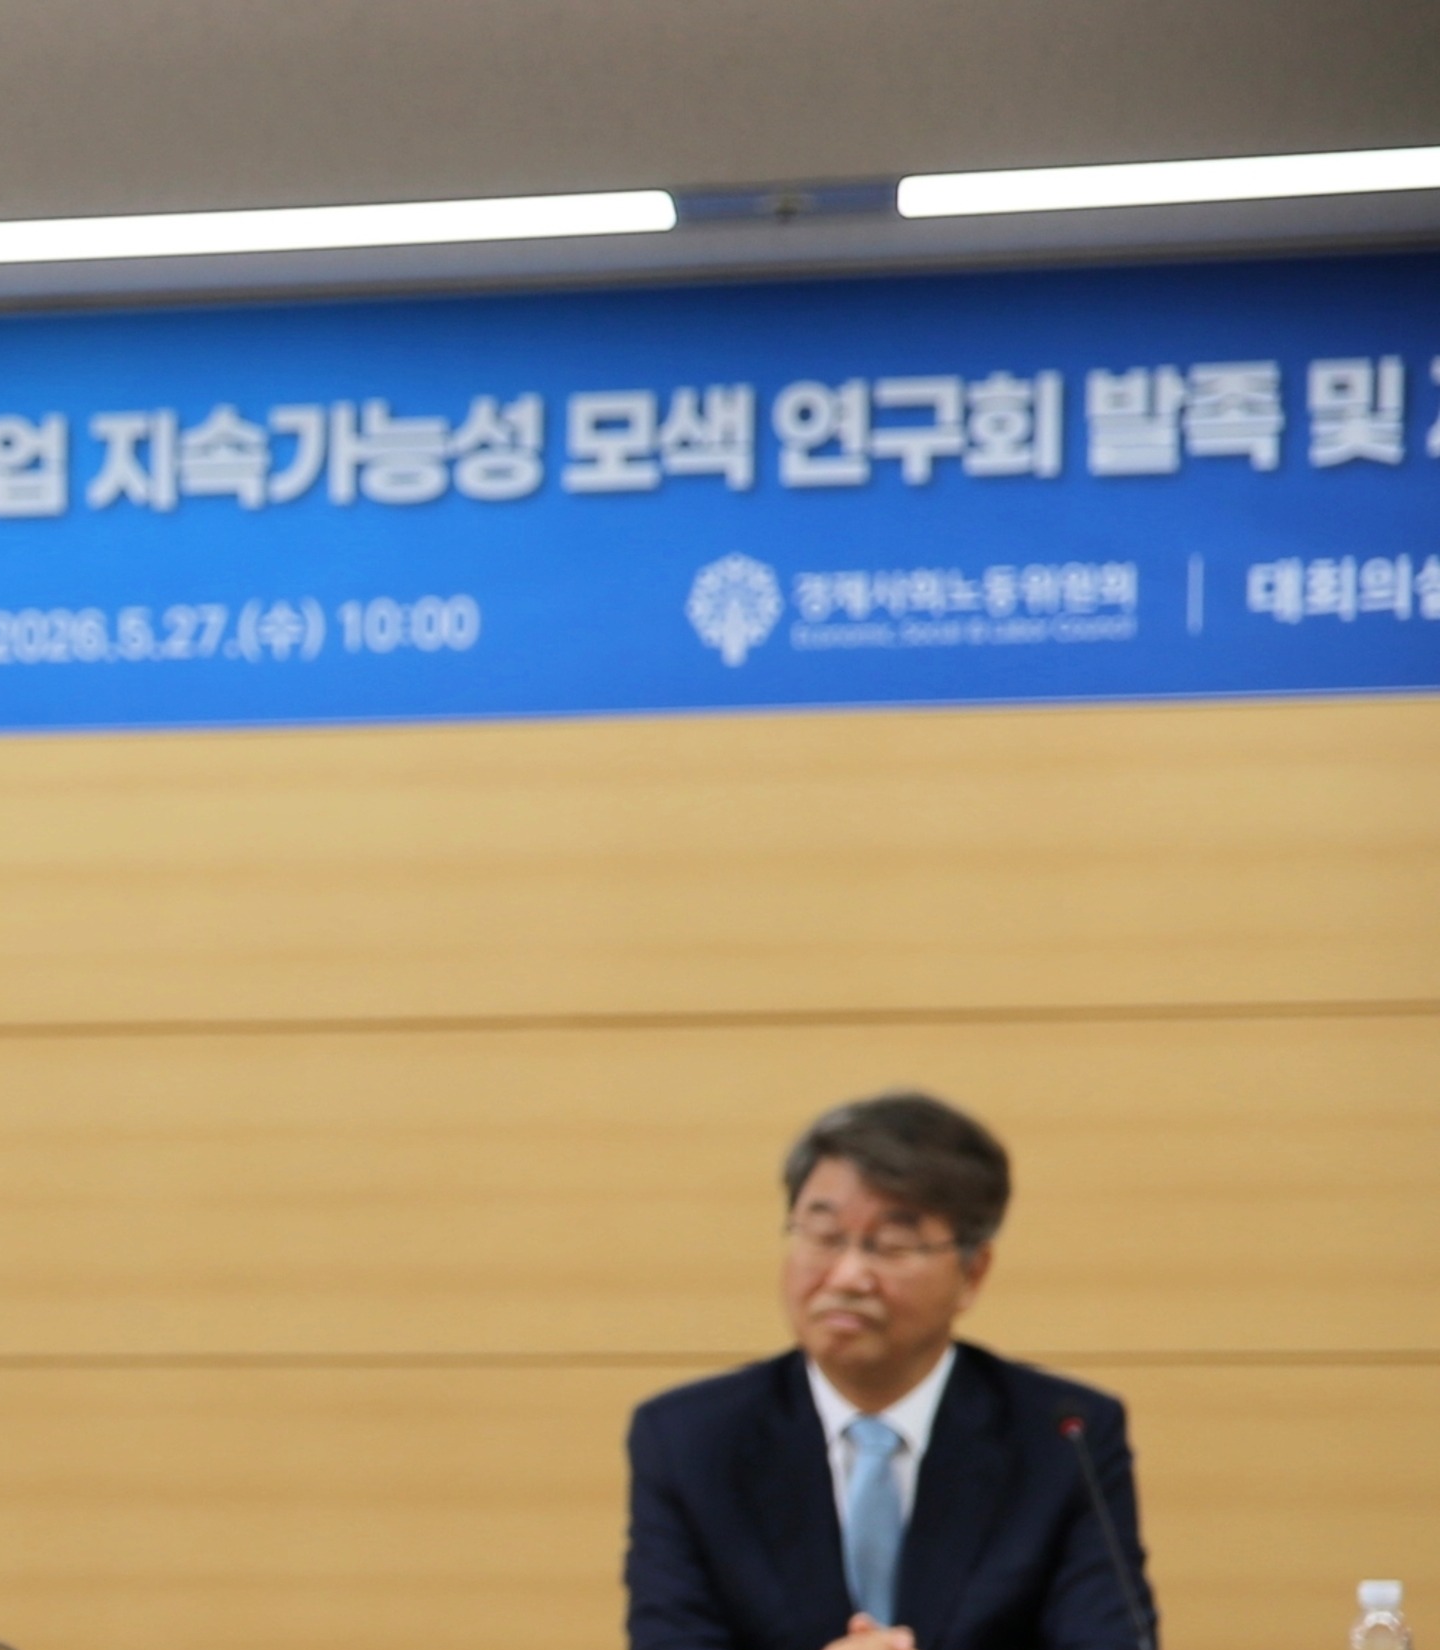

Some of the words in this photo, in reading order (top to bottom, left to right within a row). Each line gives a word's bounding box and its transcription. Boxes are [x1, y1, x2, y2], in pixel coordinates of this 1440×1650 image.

[85, 393, 546, 512] 지속가능성
[562, 381, 755, 494] 모색
[772, 367, 1064, 488] 연구회
[1085, 358, 1285, 478] 발족
[1306, 354, 1405, 468] 및
[791, 561, 1138, 622] 경제사회노동위원회
[338, 593, 480, 654] 10:00
